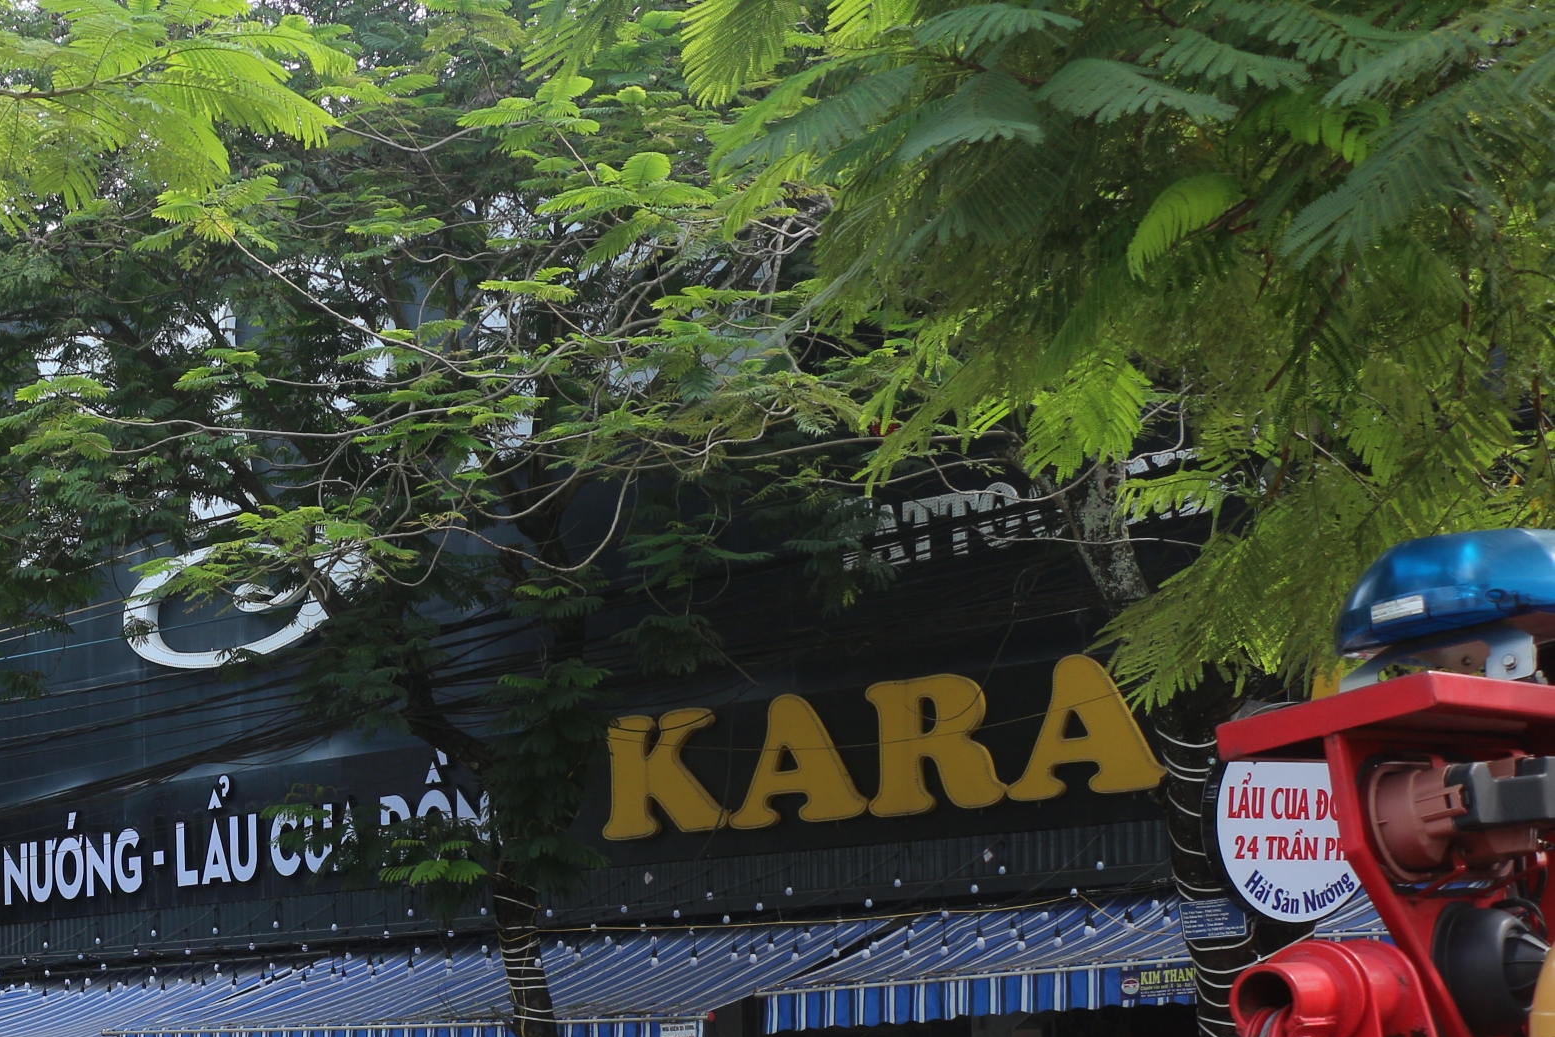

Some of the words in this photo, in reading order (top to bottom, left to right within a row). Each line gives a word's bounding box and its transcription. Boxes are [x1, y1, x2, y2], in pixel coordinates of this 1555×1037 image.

[1227, 772, 1266, 819] LẨU
[1270, 788, 1310, 820] CUA
[3, 811, 142, 906] NƯỚNG
[175, 774, 258, 887] LẨU
[1234, 836, 1259, 860] 24
[1265, 828, 1319, 861] TRẦN
[1324, 837, 1348, 861] PH
[1244, 869, 1274, 905] Hải
[1272, 888, 1300, 915] Sản
[1302, 872, 1355, 914] Nướng
[1140, 970, 1161, 985] KIM
